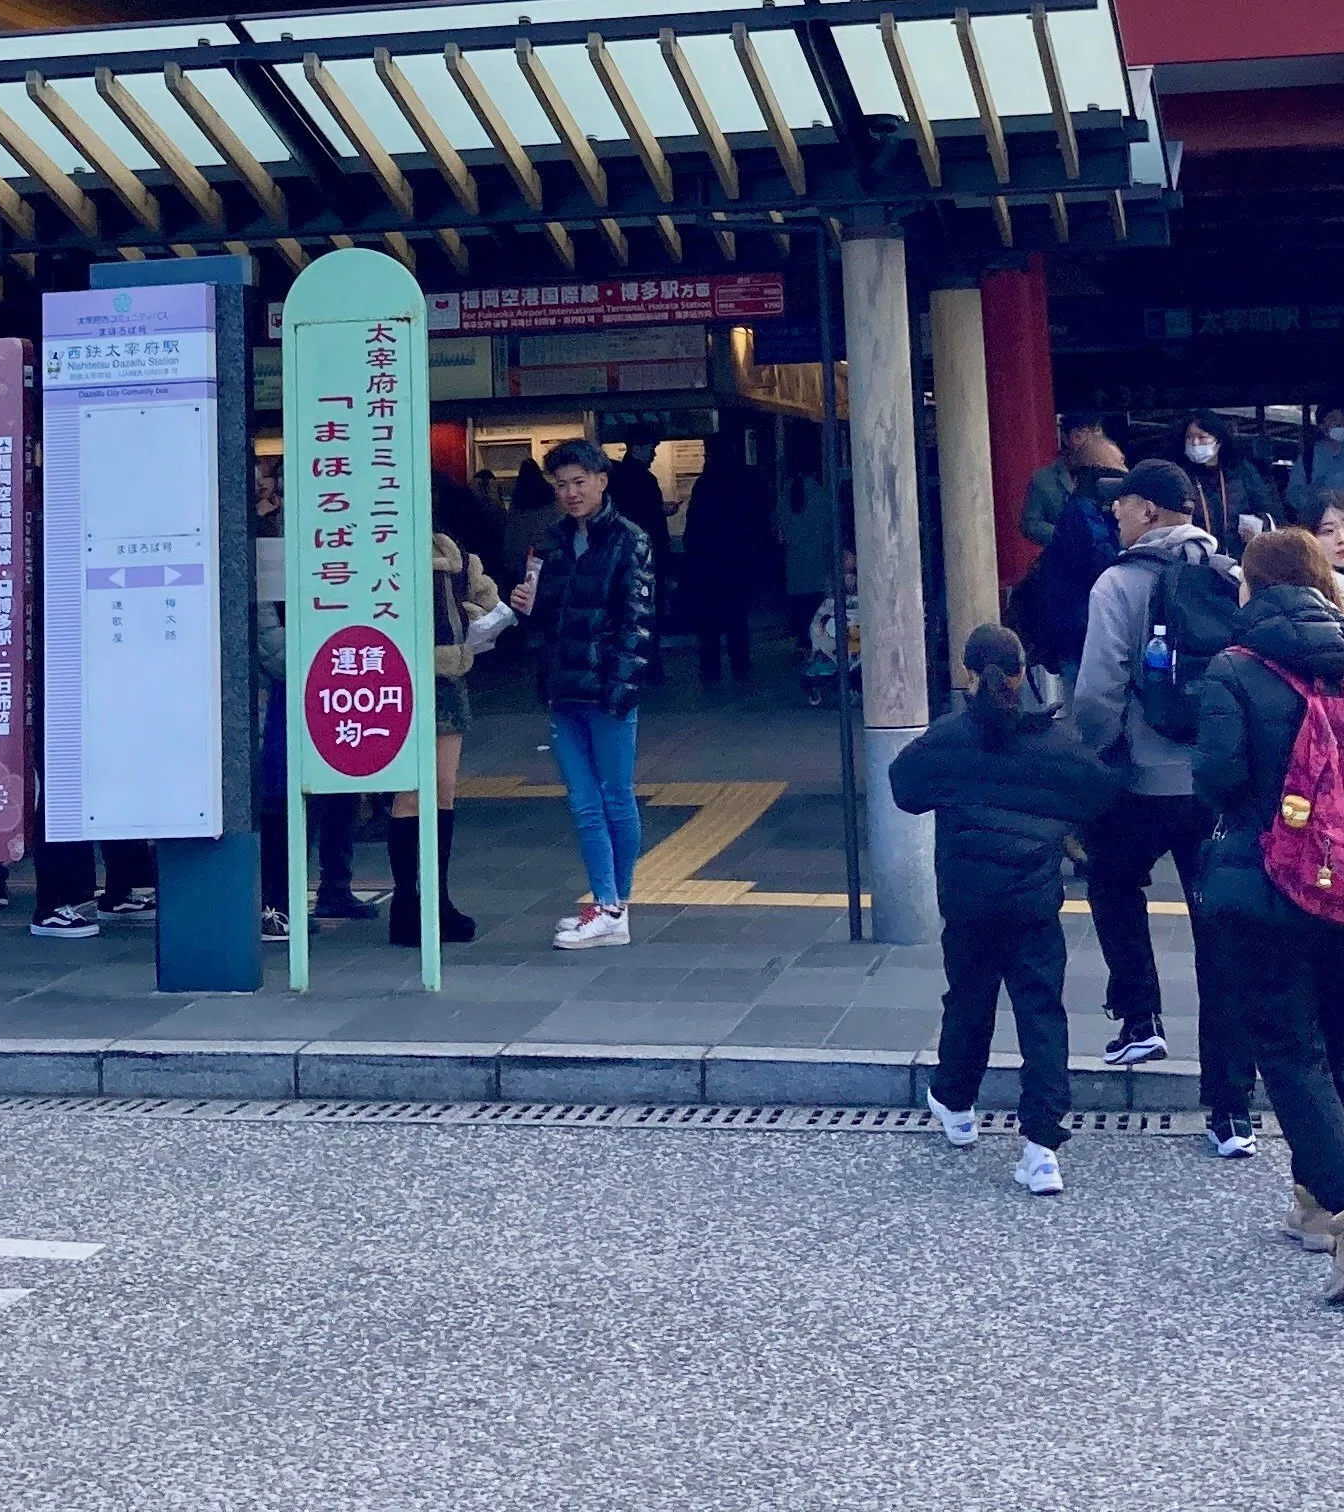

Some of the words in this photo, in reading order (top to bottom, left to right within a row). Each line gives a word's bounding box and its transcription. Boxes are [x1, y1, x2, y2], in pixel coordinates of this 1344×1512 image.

[99, 325, 147, 336] まほろば号
[67, 339, 180, 359] 西鉄太宰府駅
[67, 360, 110, 371] Nishitetsu
[112, 358, 146, 369] Dazaifu
[148, 356, 180, 367] Station
[364, 323, 401, 620] 太宰府市コミュニティバス
[312, 395, 358, 611] 「まほろば号」
[117, 541, 172, 555] まほろば号
[330, 645, 386, 676] 運賃
[319, 685, 403, 714] 100円
[336, 720, 390, 748] 均一
